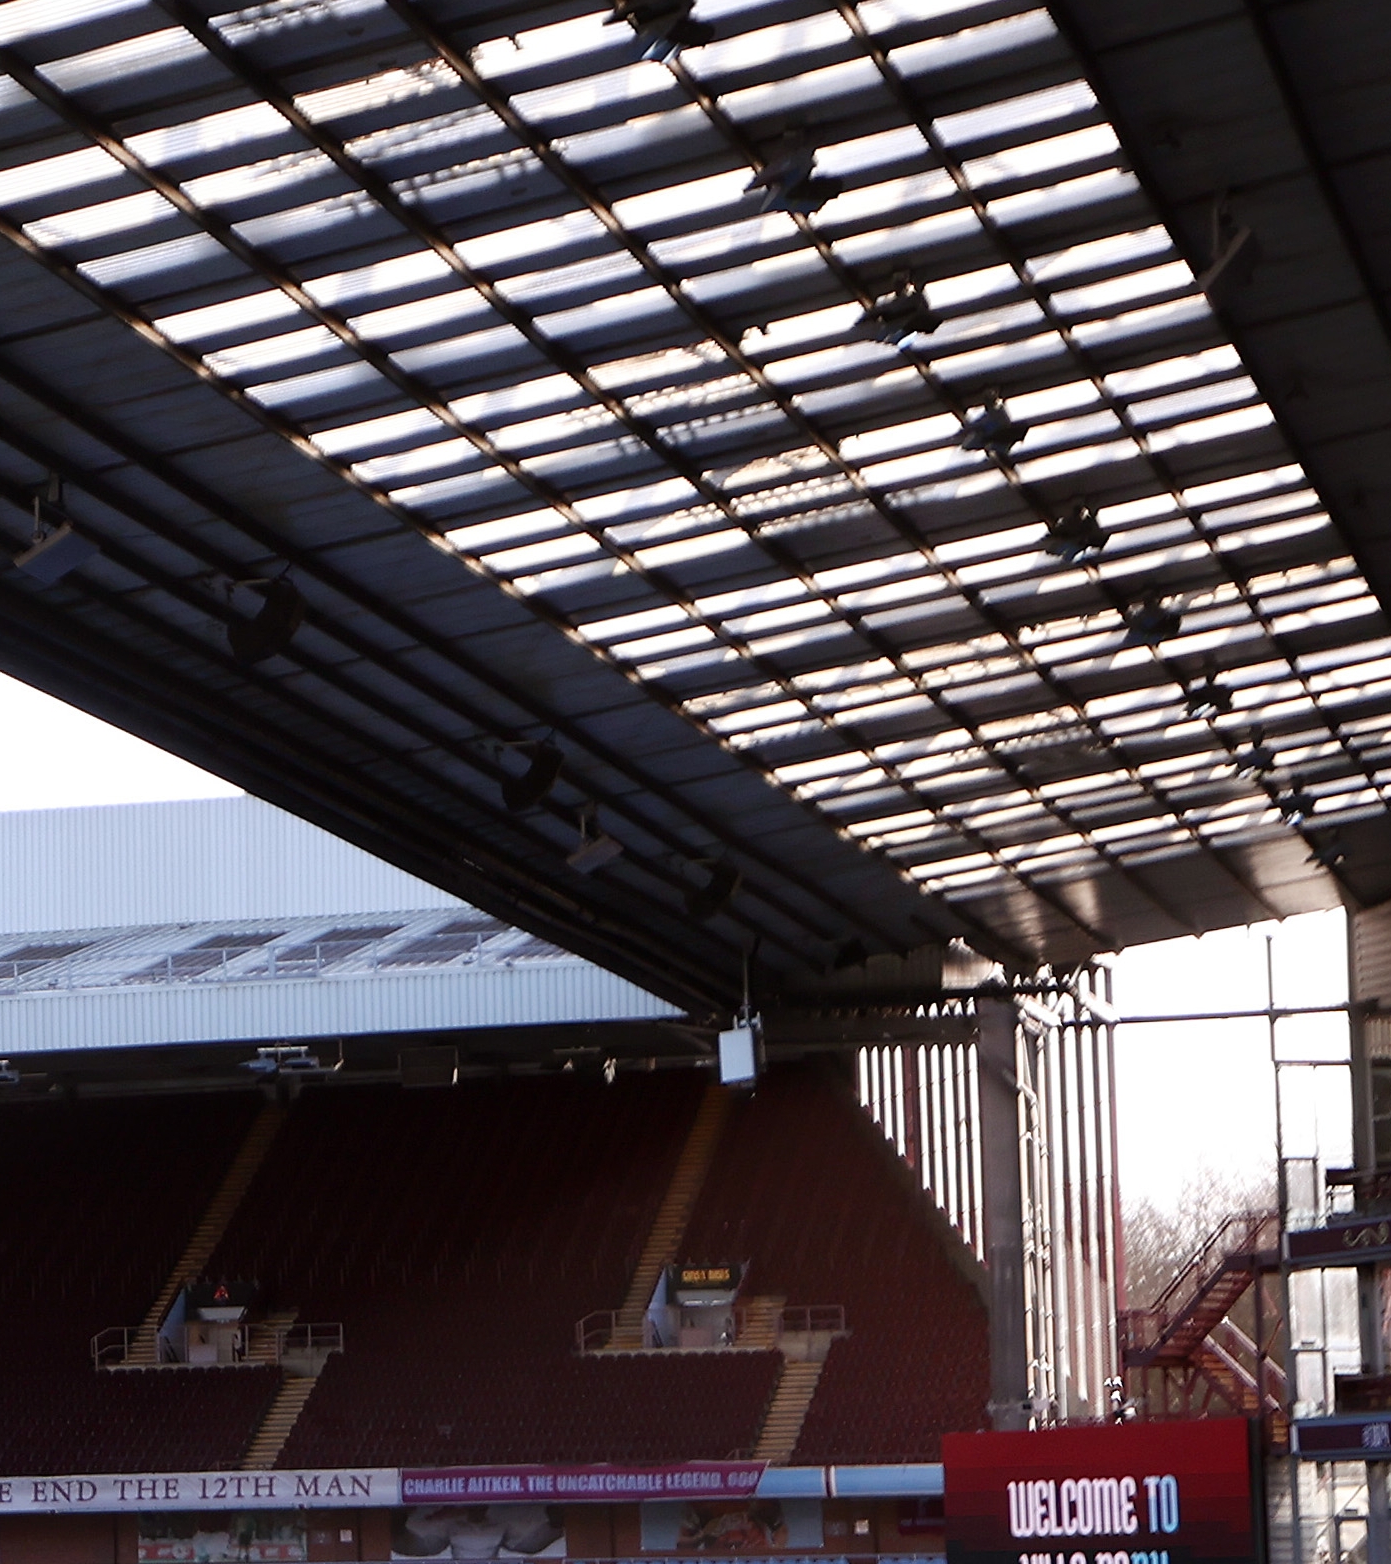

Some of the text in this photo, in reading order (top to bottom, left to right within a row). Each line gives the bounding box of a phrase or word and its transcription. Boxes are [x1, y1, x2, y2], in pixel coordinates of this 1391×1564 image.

[31, 1479, 98, 1503] END
[113, 1477, 180, 1502] THE
[198, 1475, 277, 1500] 12TH
[294, 1473, 373, 1498] MAN
[404, 1477, 466, 1496] CHARLIE
[467, 1475, 525, 1494] AITKEN.
[526, 1475, 555, 1493] THE
[556, 1472, 664, 1493] UNCATCHABLE
[1006, 1474, 1180, 1538] WELCOME TO
